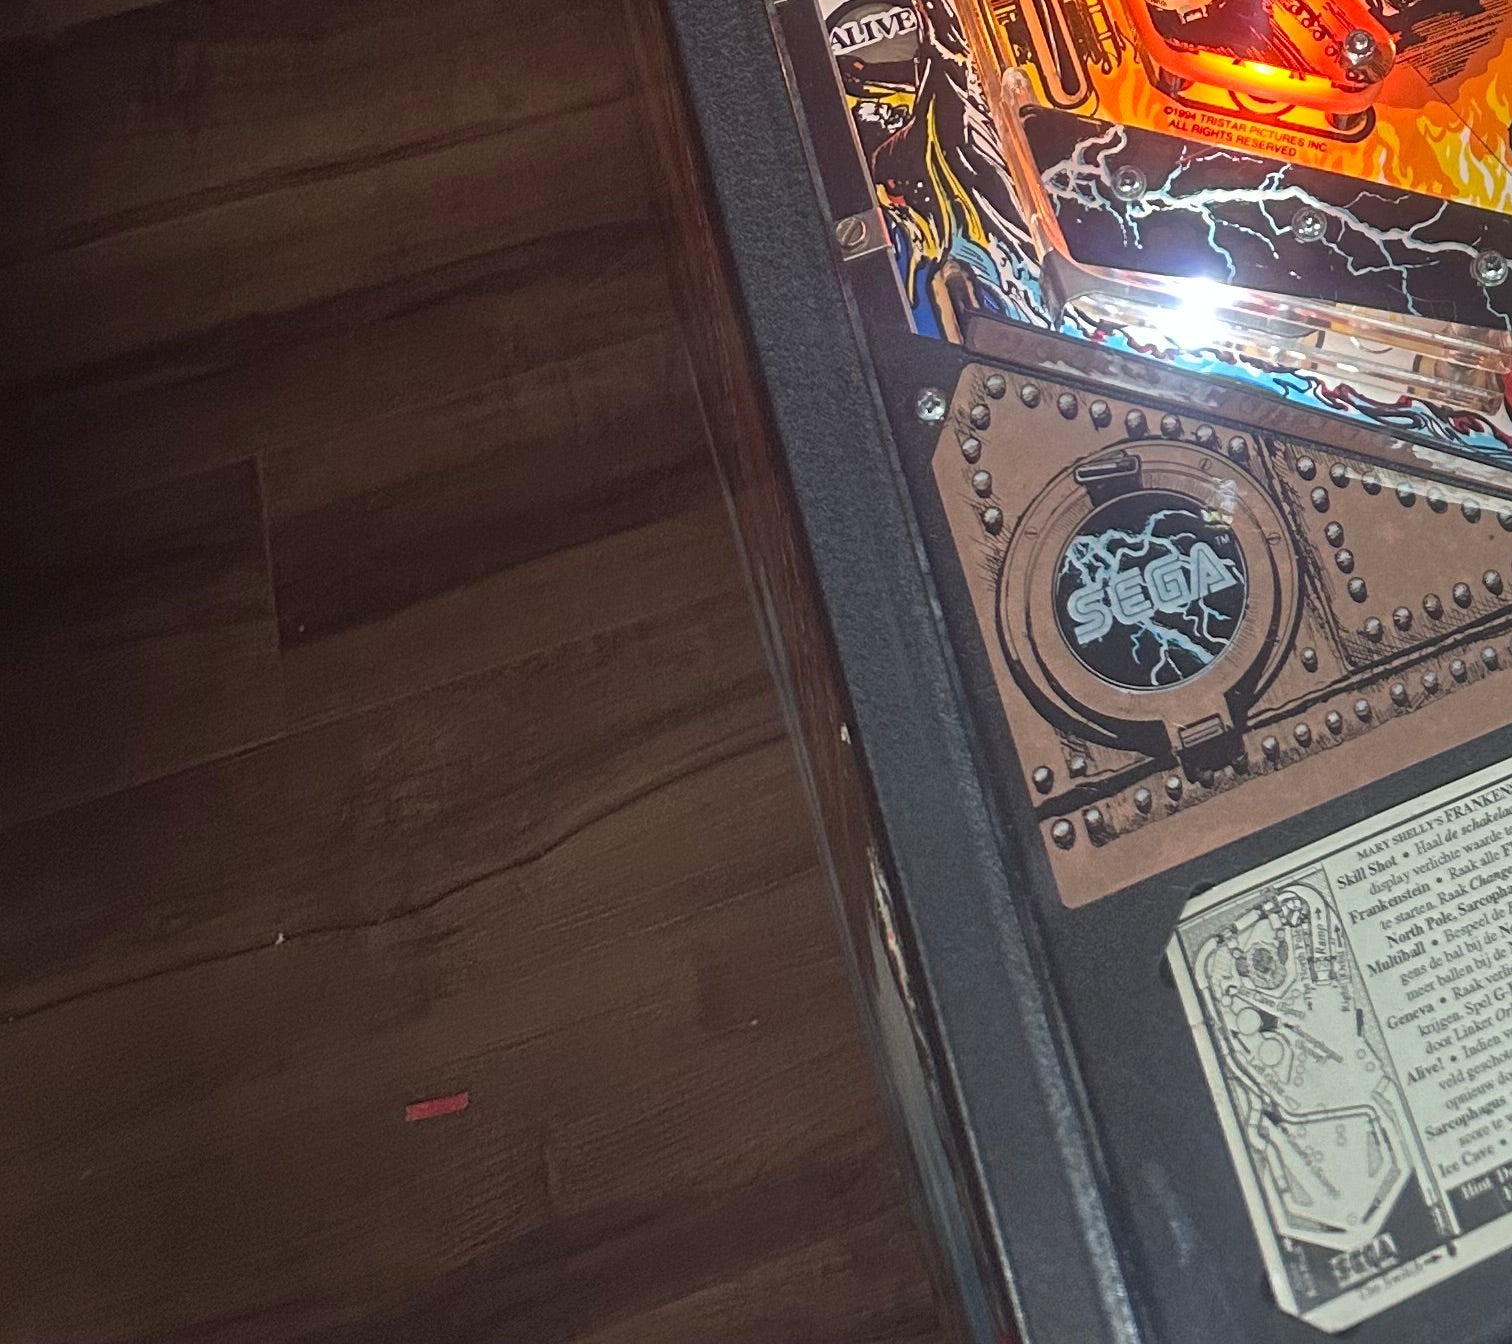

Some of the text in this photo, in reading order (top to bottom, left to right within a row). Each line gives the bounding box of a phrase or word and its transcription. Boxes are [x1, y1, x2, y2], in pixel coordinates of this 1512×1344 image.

[830, 10, 916, 49] ALIVE
[1168, 118, 1298, 158] ALL RIGHTS RESERVED
[1199, 108, 1247, 133] TRISTAR
[1249, 123, 1305, 147] PICTURES
[1067, 542, 1238, 645] SEGA
[1334, 866, 1368, 889] Skill
[1366, 853, 1398, 876] Shot
[1413, 833, 1443, 855] Haal
[1440, 826, 1460, 843] de
[1356, 839, 1391, 860] MARY
[1385, 921, 1424, 948] North
[1424, 906, 1457, 931] Pole,
[1333, 1231, 1398, 1287] SEGA
